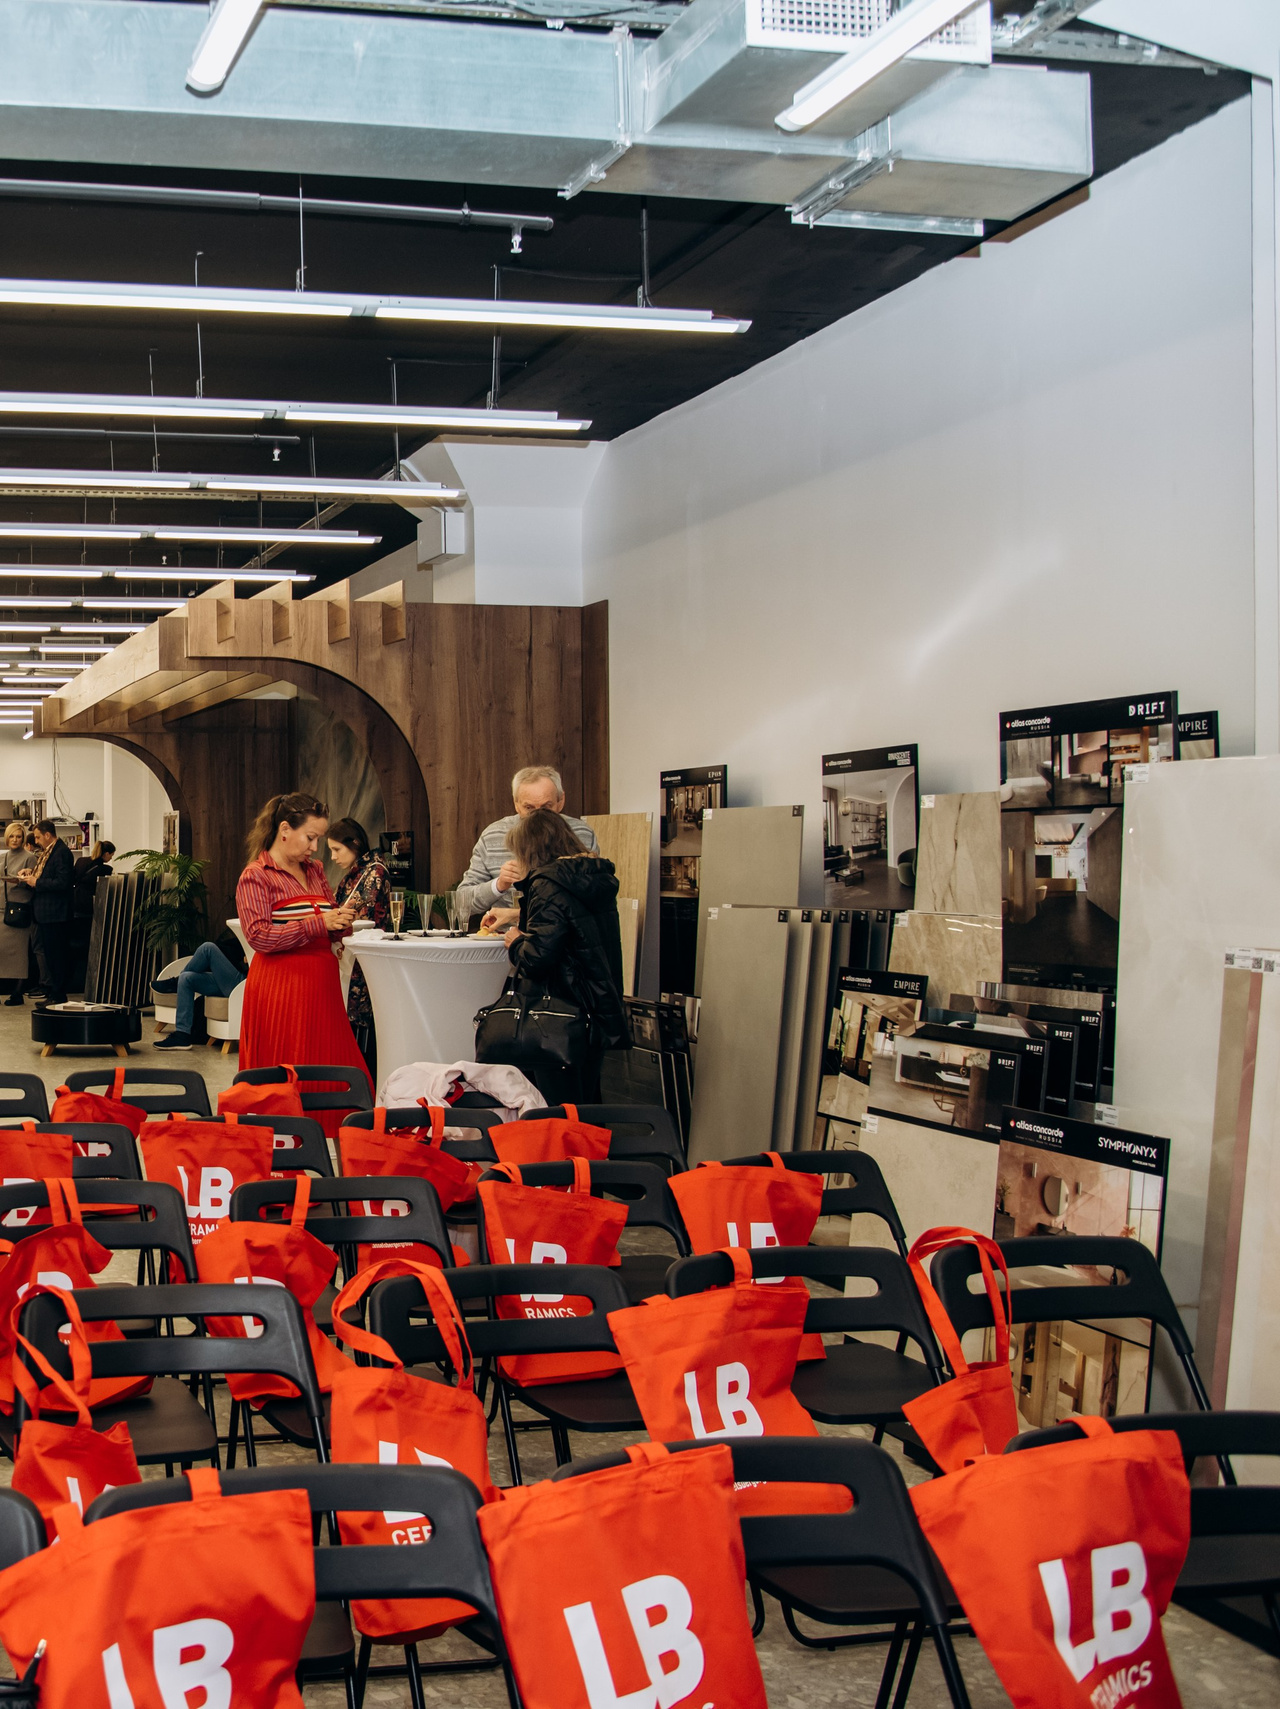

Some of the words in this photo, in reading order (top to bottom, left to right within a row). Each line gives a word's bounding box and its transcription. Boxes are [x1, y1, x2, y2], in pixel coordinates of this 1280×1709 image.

[1128, 701, 1165, 717] DRIFT
[1177, 719, 1208, 732] MPIRE
[893, 979, 920, 992] EMPIRE
[1081, 1015, 1099, 1024] DRIFT
[1055, 1029, 1073, 1038] DRIFT
[1026, 1043, 1043, 1053] DRIFT
[997, 1058, 1015, 1067] DRIFT
[1016, 1119, 1033, 1131] atlas
[1033, 1125, 1064, 1138] concorde
[1038, 1134, 1062, 1144] RUSSIA
[1098, 1136, 1157, 1159] SYMPHONYX
[176, 1165, 234, 1219] LB
[683, 1361, 765, 1440] LB
[1038, 1541, 1152, 1683] LB
[563, 1574, 705, 1709] LB
